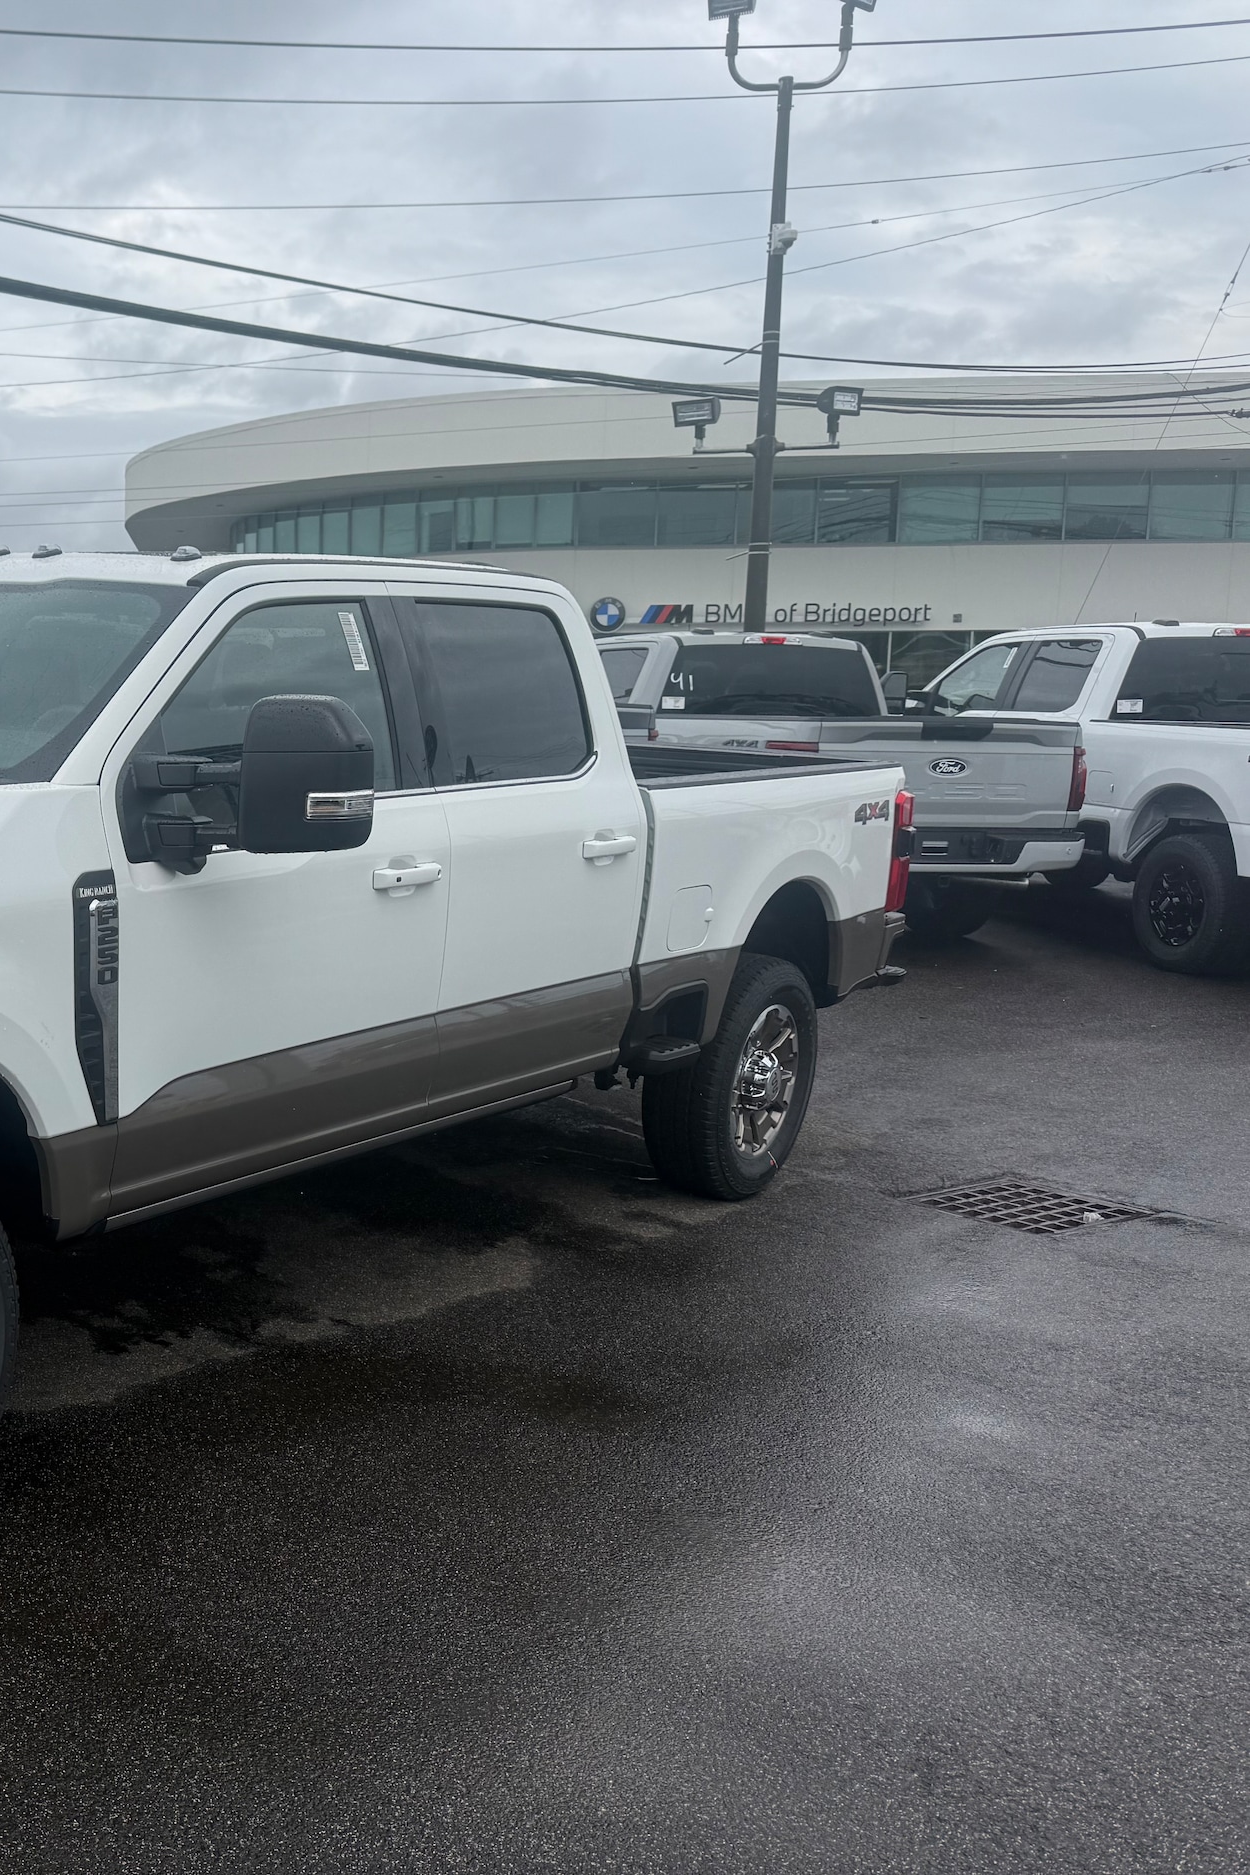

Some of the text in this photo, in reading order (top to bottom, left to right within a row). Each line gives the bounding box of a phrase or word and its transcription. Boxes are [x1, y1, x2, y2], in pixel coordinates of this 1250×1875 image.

[704, 603, 744, 624] BM
[774, 603, 798, 623] of
[804, 602, 932, 627] Bridgeport
[670, 672, 694, 691] 41
[935, 760, 962, 774] Ford
[79, 884, 114, 899] KING RANCH
